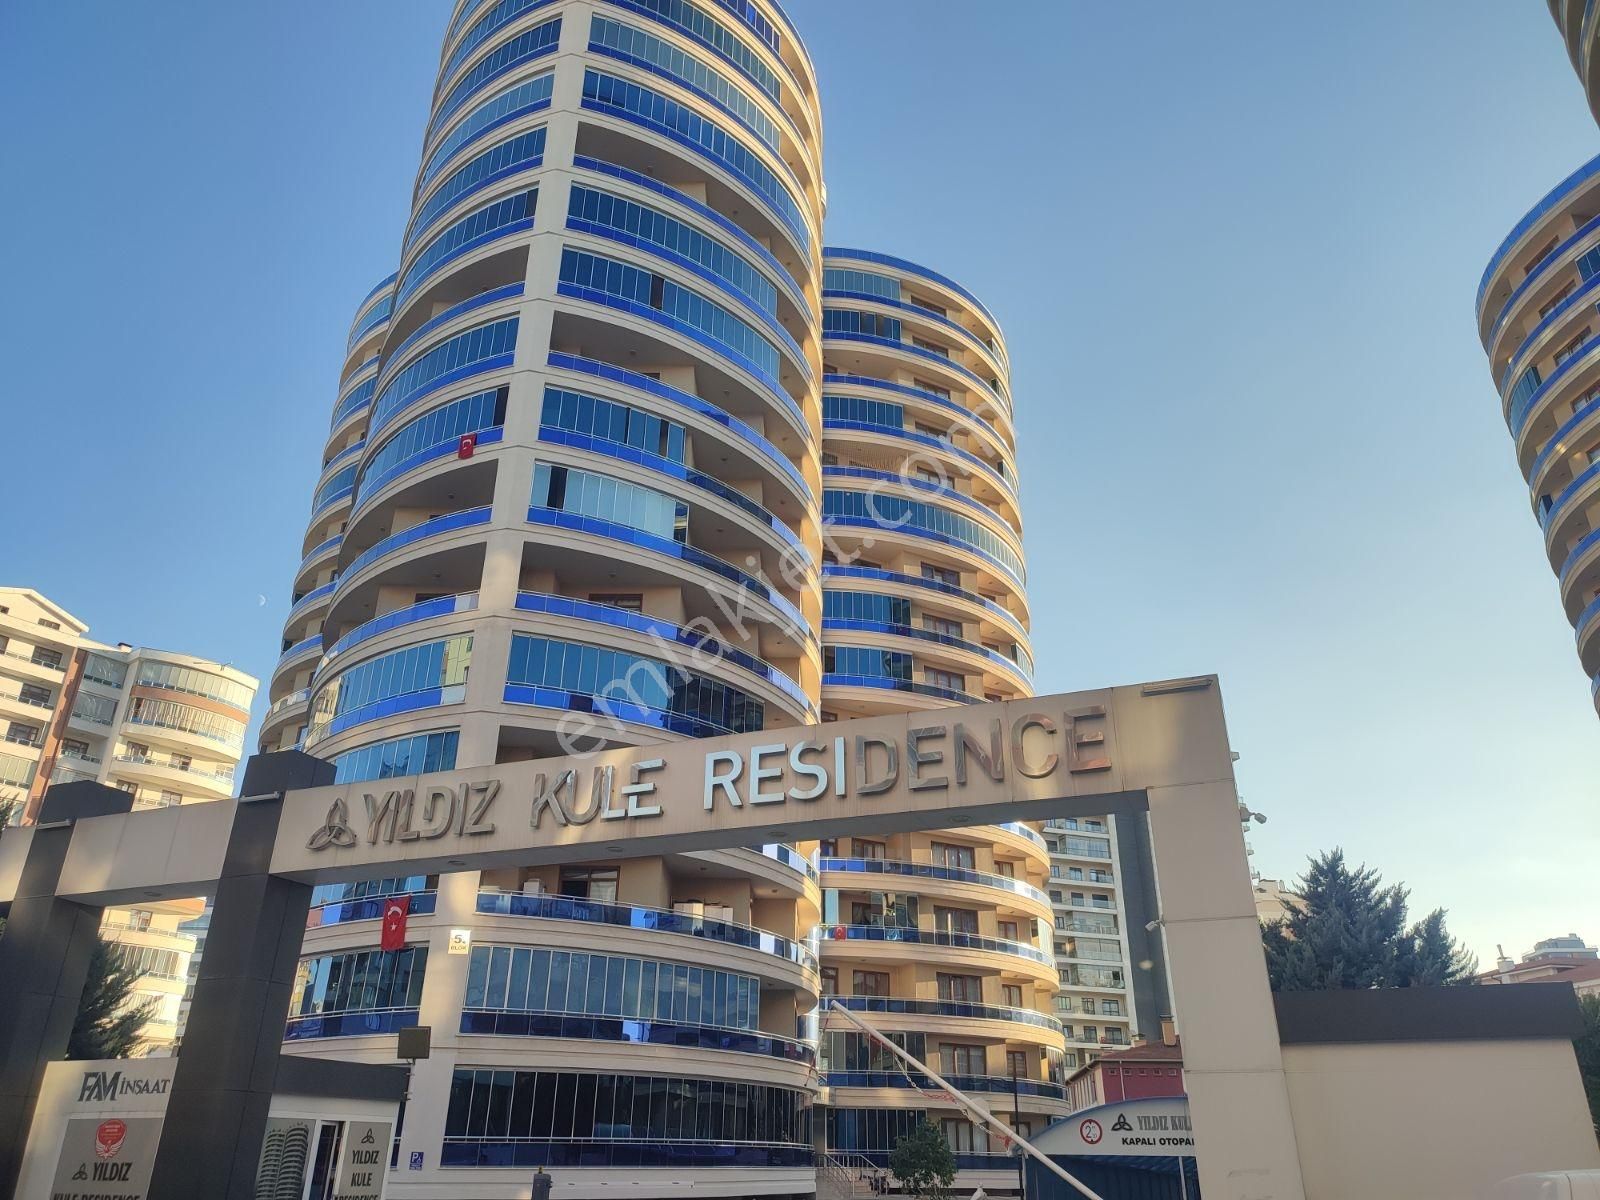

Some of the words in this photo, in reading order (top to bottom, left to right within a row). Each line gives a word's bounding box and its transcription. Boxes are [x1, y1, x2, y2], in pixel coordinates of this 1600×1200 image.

[363, 779, 501, 845] YILDIZ
[529, 758, 667, 829] KULE
[703, 704, 1112, 811] RESIDENCE
[1137, 1116, 1169, 1131] YILDIZ
[1122, 1137, 1156, 1146] KAPALI
[1159, 1137, 1195, 1146] OTOPA
[351, 1150, 380, 1164] YILDIZ
[92, 1162, 133, 1181] YILDIZ
[351, 1172, 373, 1187] KULE
